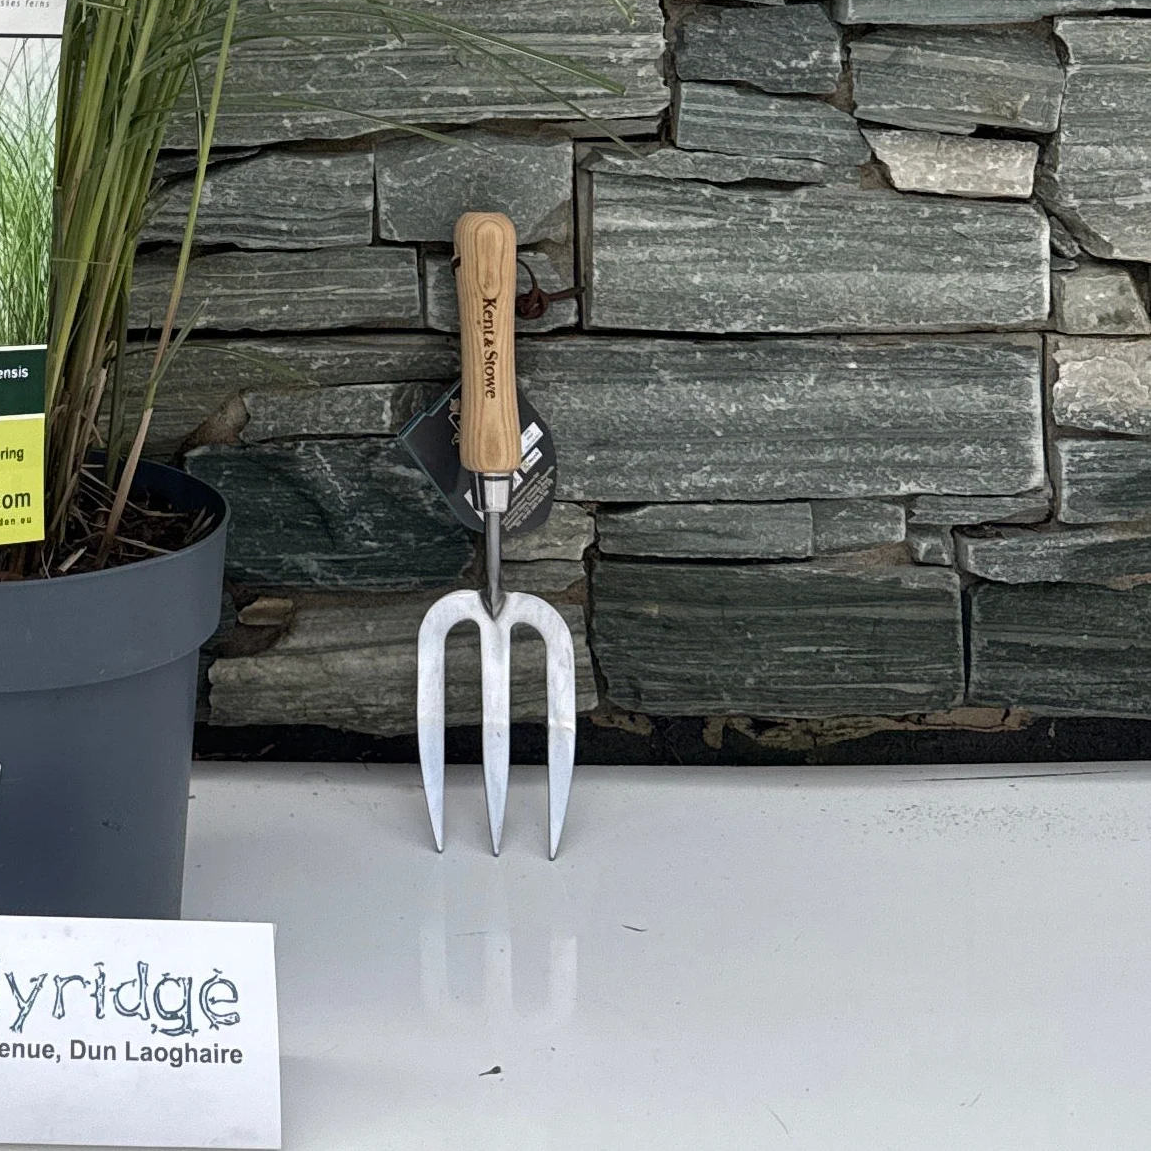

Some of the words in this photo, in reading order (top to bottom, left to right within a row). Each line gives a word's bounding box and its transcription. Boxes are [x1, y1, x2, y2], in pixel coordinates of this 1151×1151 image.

[482, 298, 497, 336] Kent
[483, 337, 494, 348] &
[483, 350, 498, 399] Stowe
[70, 1039, 117, 1061] Dun
[125, 1041, 243, 1068] Laoghaire
